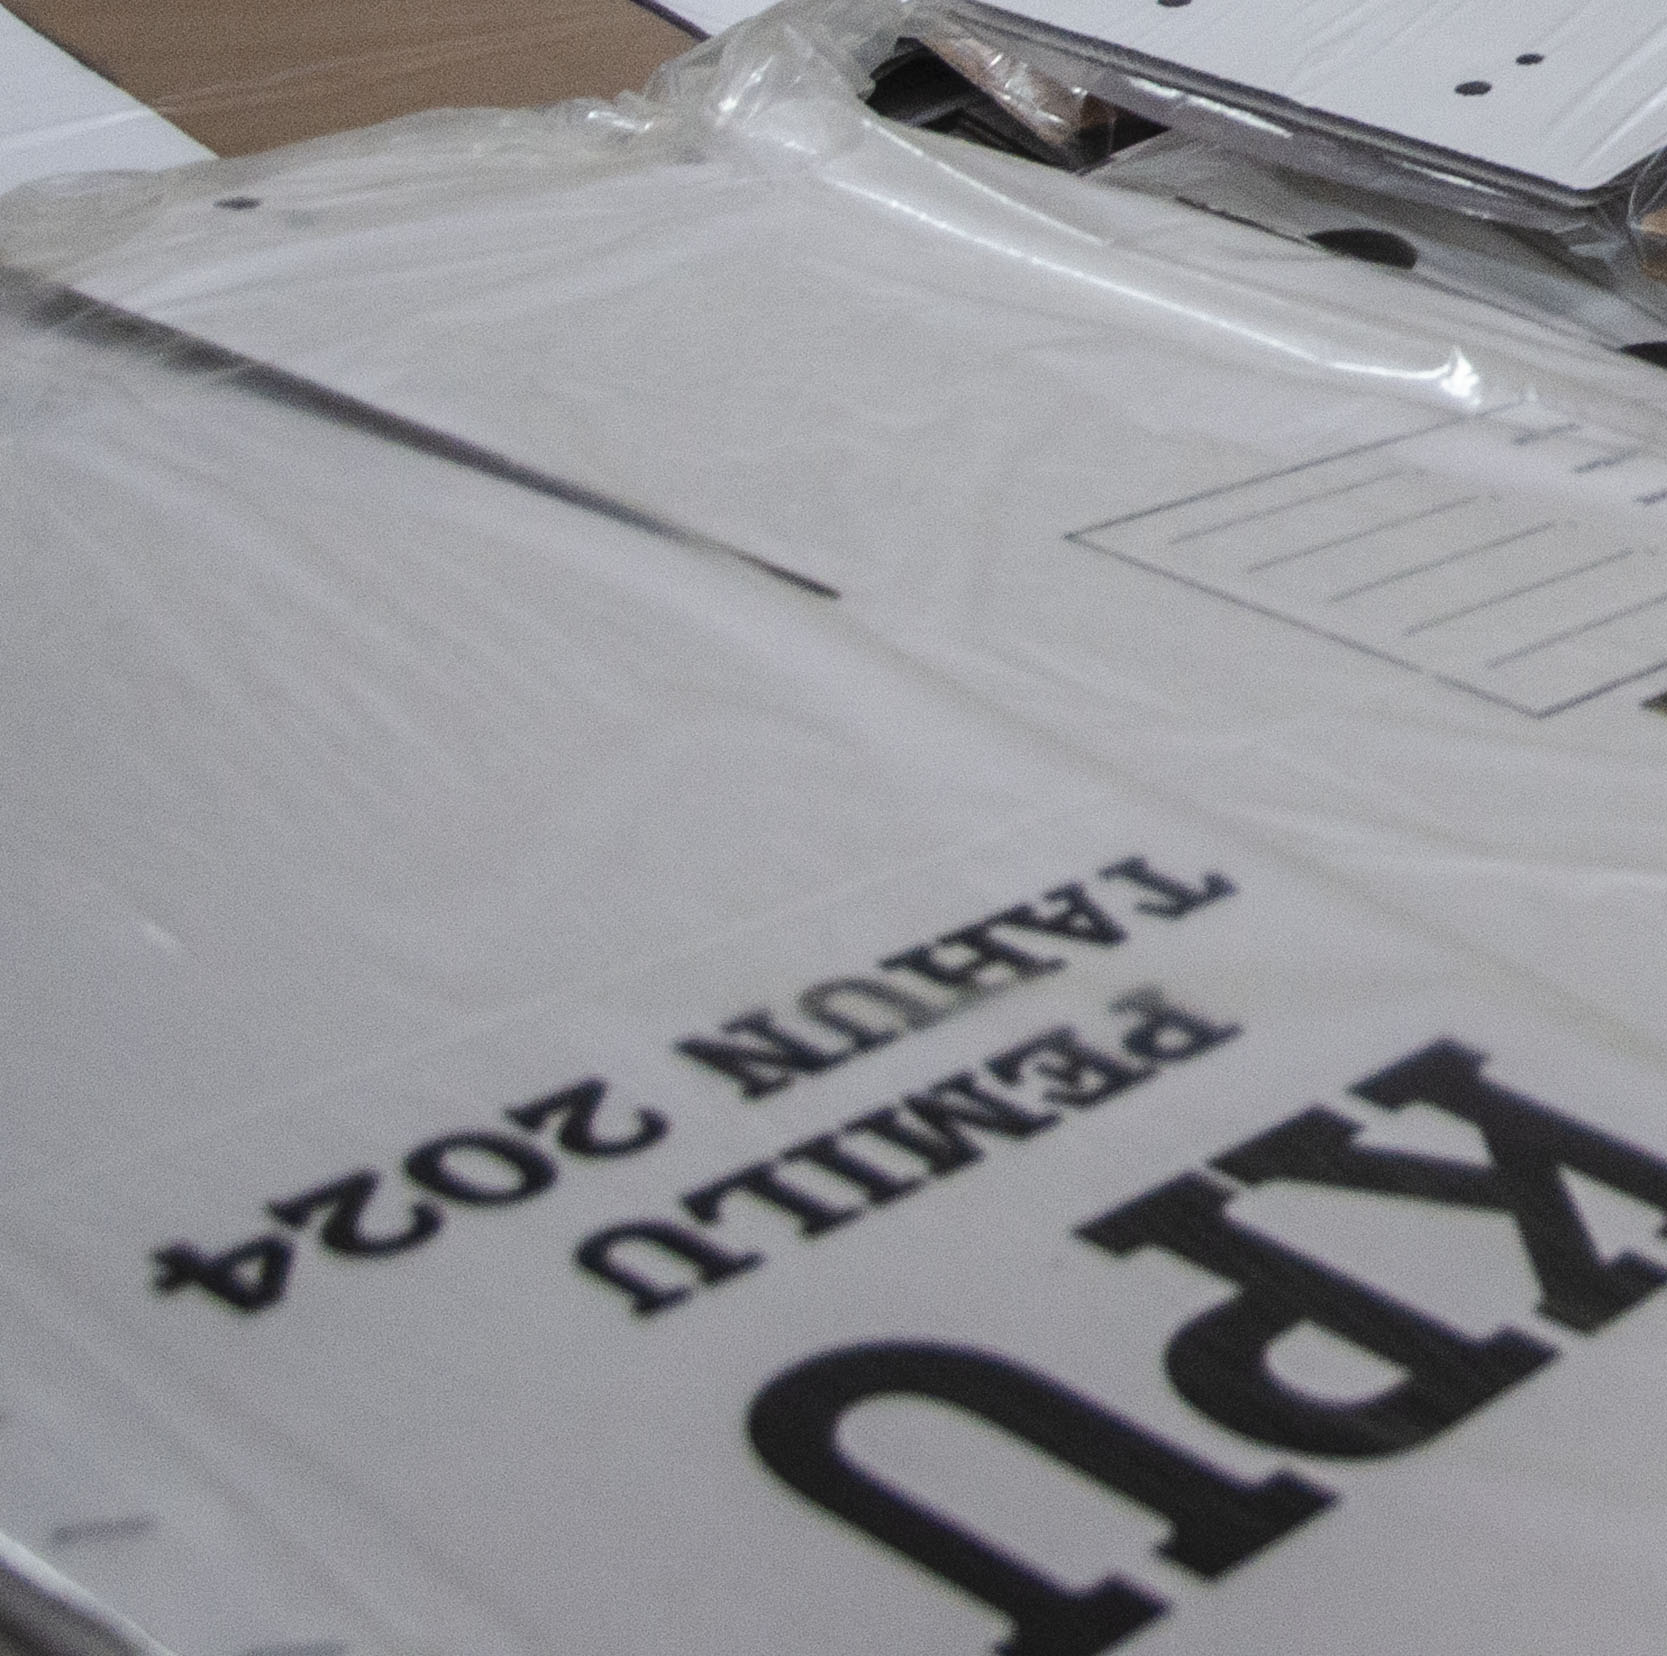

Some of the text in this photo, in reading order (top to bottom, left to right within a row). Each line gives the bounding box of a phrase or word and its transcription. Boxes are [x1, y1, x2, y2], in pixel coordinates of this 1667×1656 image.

[149, 856, 1237, 1314] TAHUN 2024
[573, 987, 1243, 1317] PEMILU
